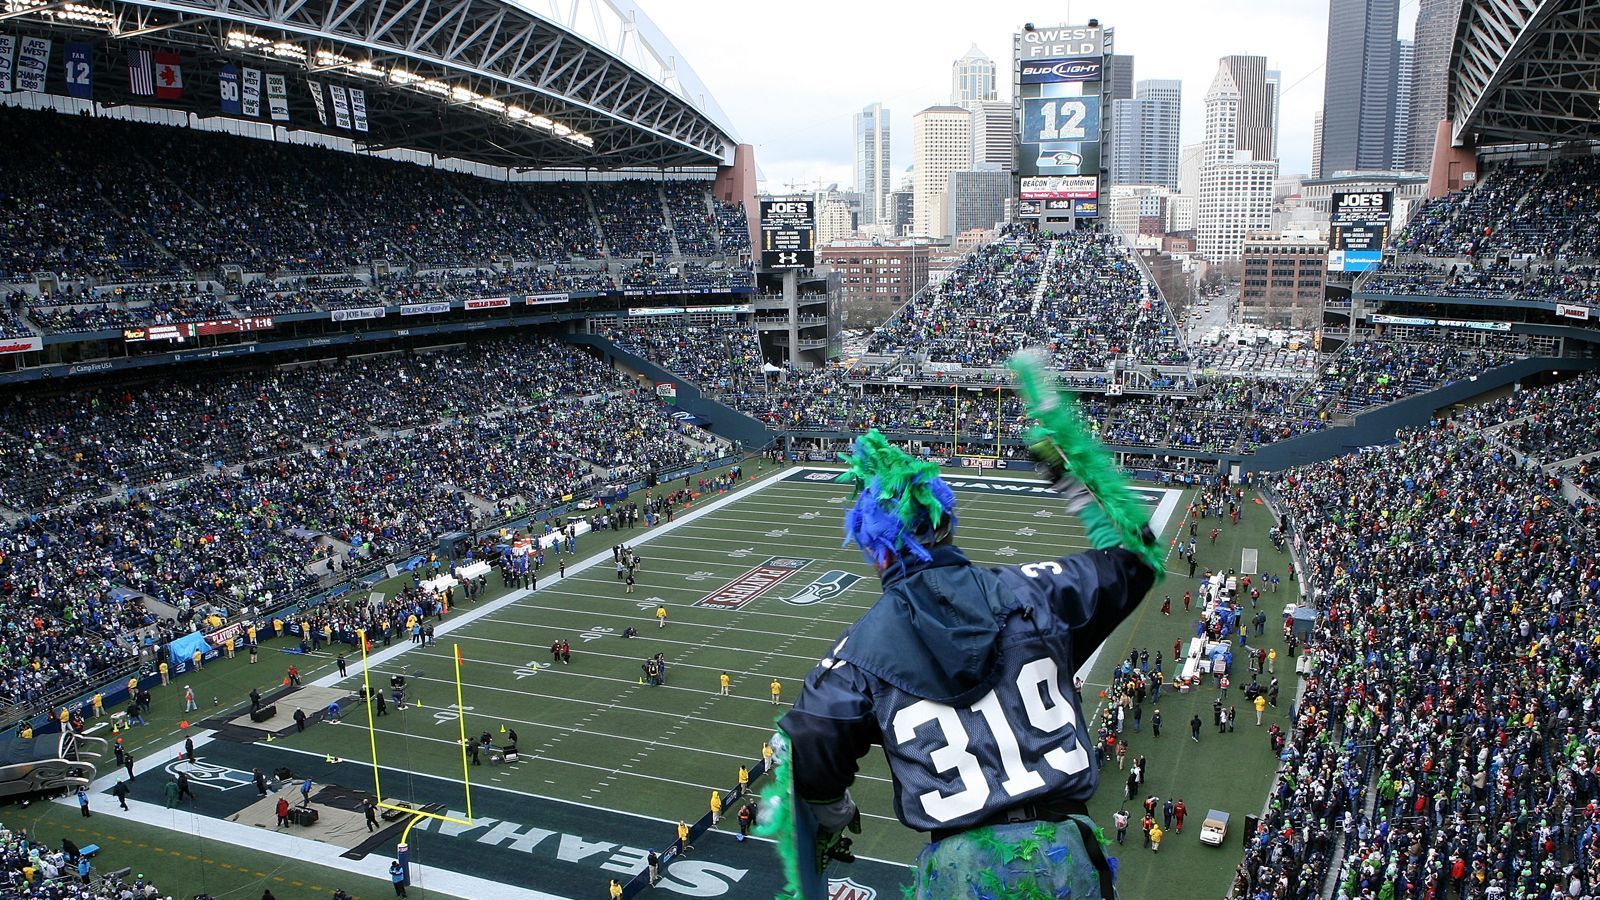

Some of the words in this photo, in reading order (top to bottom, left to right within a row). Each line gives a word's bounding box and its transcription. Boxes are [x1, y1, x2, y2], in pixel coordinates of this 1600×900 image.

[1024, 28, 1099, 44] QWEST
[28, 39, 46, 49] AFC
[1030, 43, 1095, 57] FIELD
[22, 46, 48, 57] WEST
[71, 52, 85, 60] FAN
[65, 60, 91, 85] 12
[1023, 67, 1052, 75] BUD
[1058, 64, 1100, 74] LIGHT
[17, 70, 45, 82] CHAMPS
[268, 77, 283, 86] 2005
[21, 79, 38, 90] 1999
[220, 79, 239, 102] 80
[1040, 101, 1086, 140] 12
[1022, 180, 1048, 188] BEACON
[1062, 179, 1095, 187] PLUMBING
[1338, 193, 1384, 207] JOE'S
[767, 202, 808, 214] JOE'S
[468, 301, 489, 309] WELLS
[254, 318, 272, 328] 1:16
[949, 480, 1062, 494] HAWK
[713, 567, 787, 604] PLAYOFFS
[699, 602, 734, 610] 2007
[212, 625, 240, 643] PLAYOFFS
[893, 656, 1089, 822] 319
